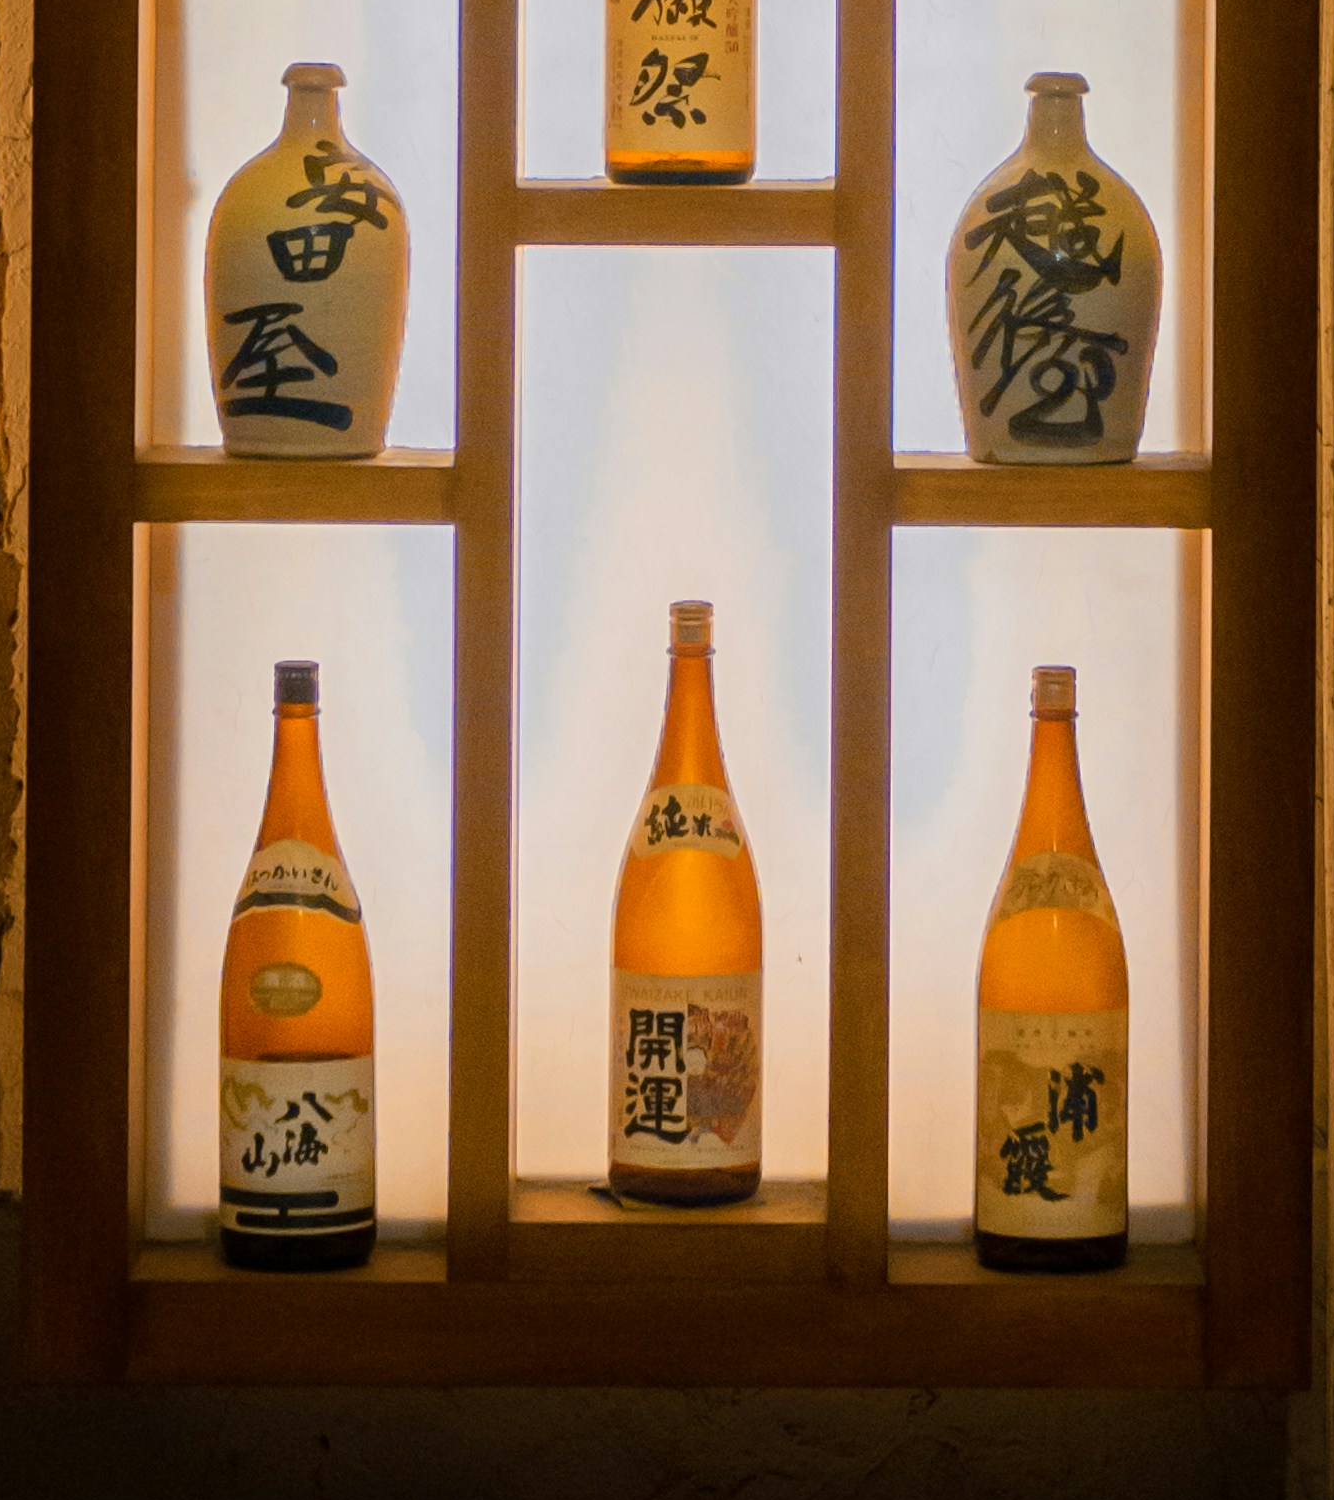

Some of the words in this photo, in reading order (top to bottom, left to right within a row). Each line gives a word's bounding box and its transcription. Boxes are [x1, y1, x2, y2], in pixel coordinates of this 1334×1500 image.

[624, 1006, 692, 1144] 開運
[241, 1090, 335, 1179] 八海山
